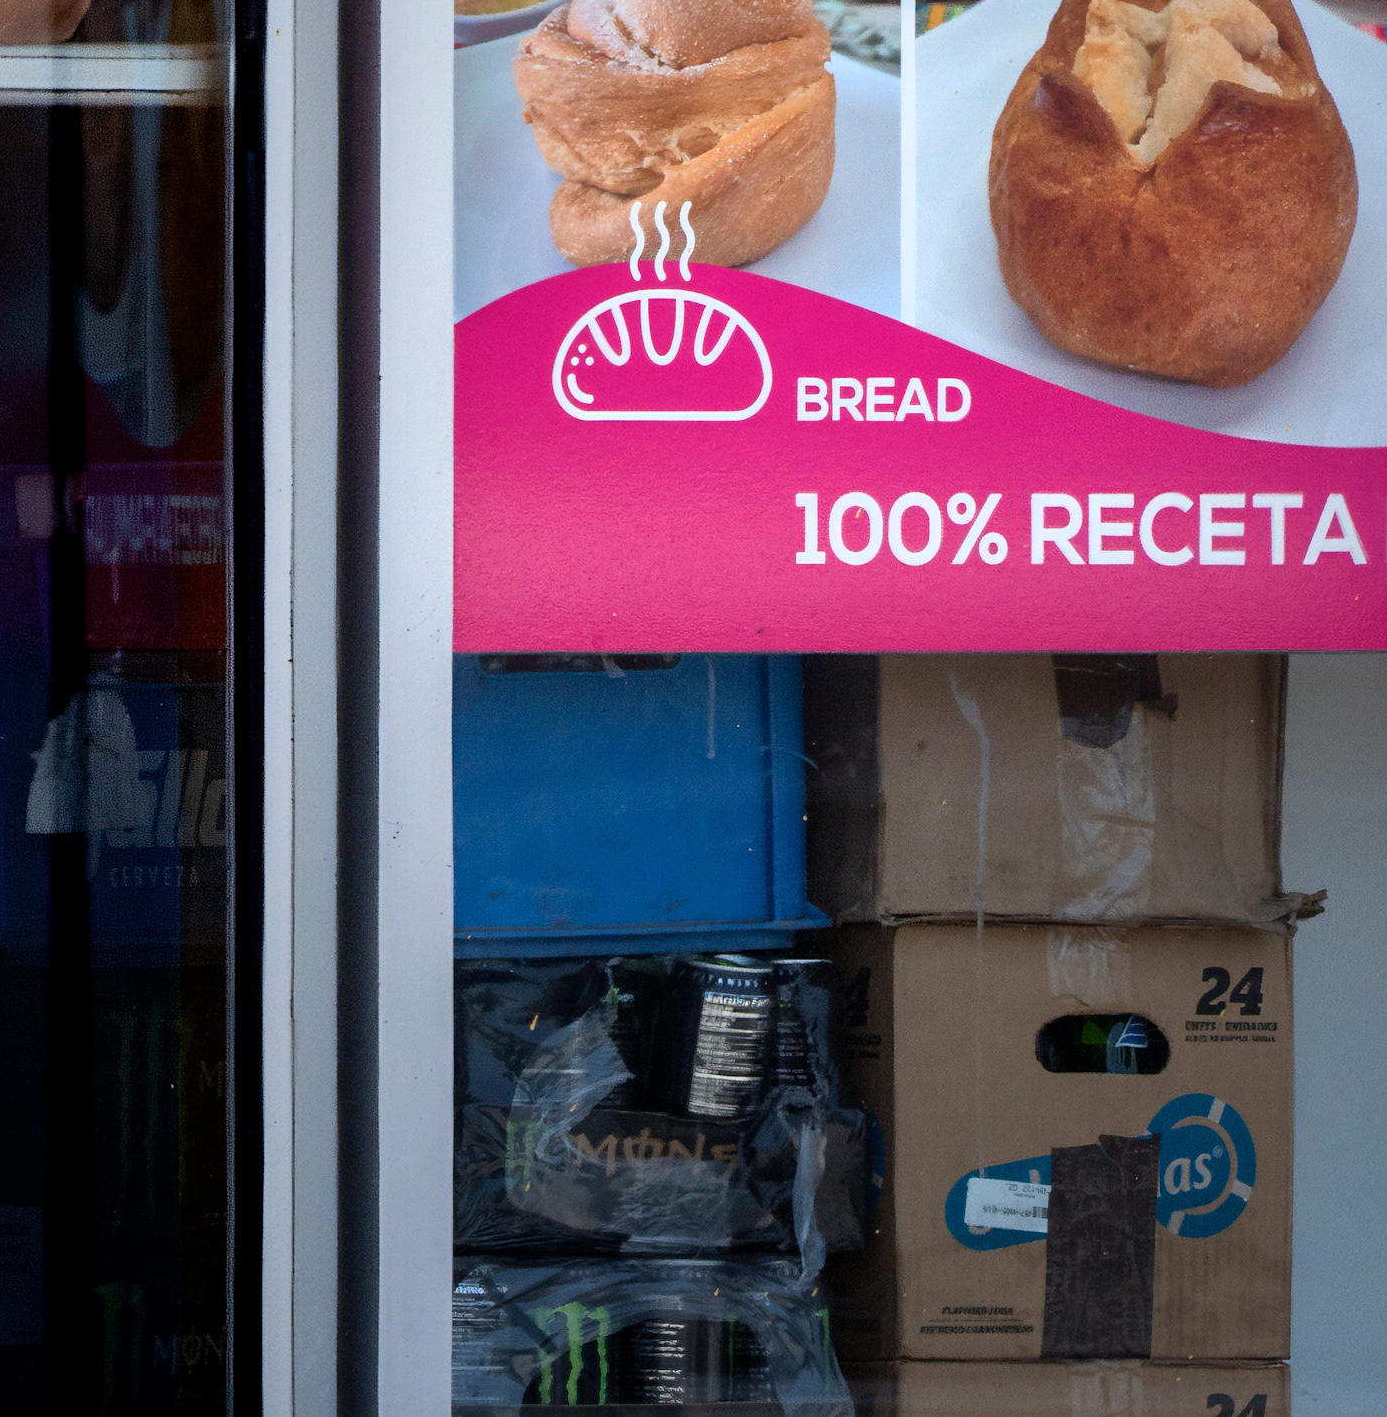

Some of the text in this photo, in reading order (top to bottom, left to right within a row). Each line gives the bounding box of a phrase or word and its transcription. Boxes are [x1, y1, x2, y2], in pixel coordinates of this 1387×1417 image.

[796, 377, 972, 422] BREAD
[794, 492, 1367, 566] 100% RECETA
[1196, 967, 1263, 1015] 24
